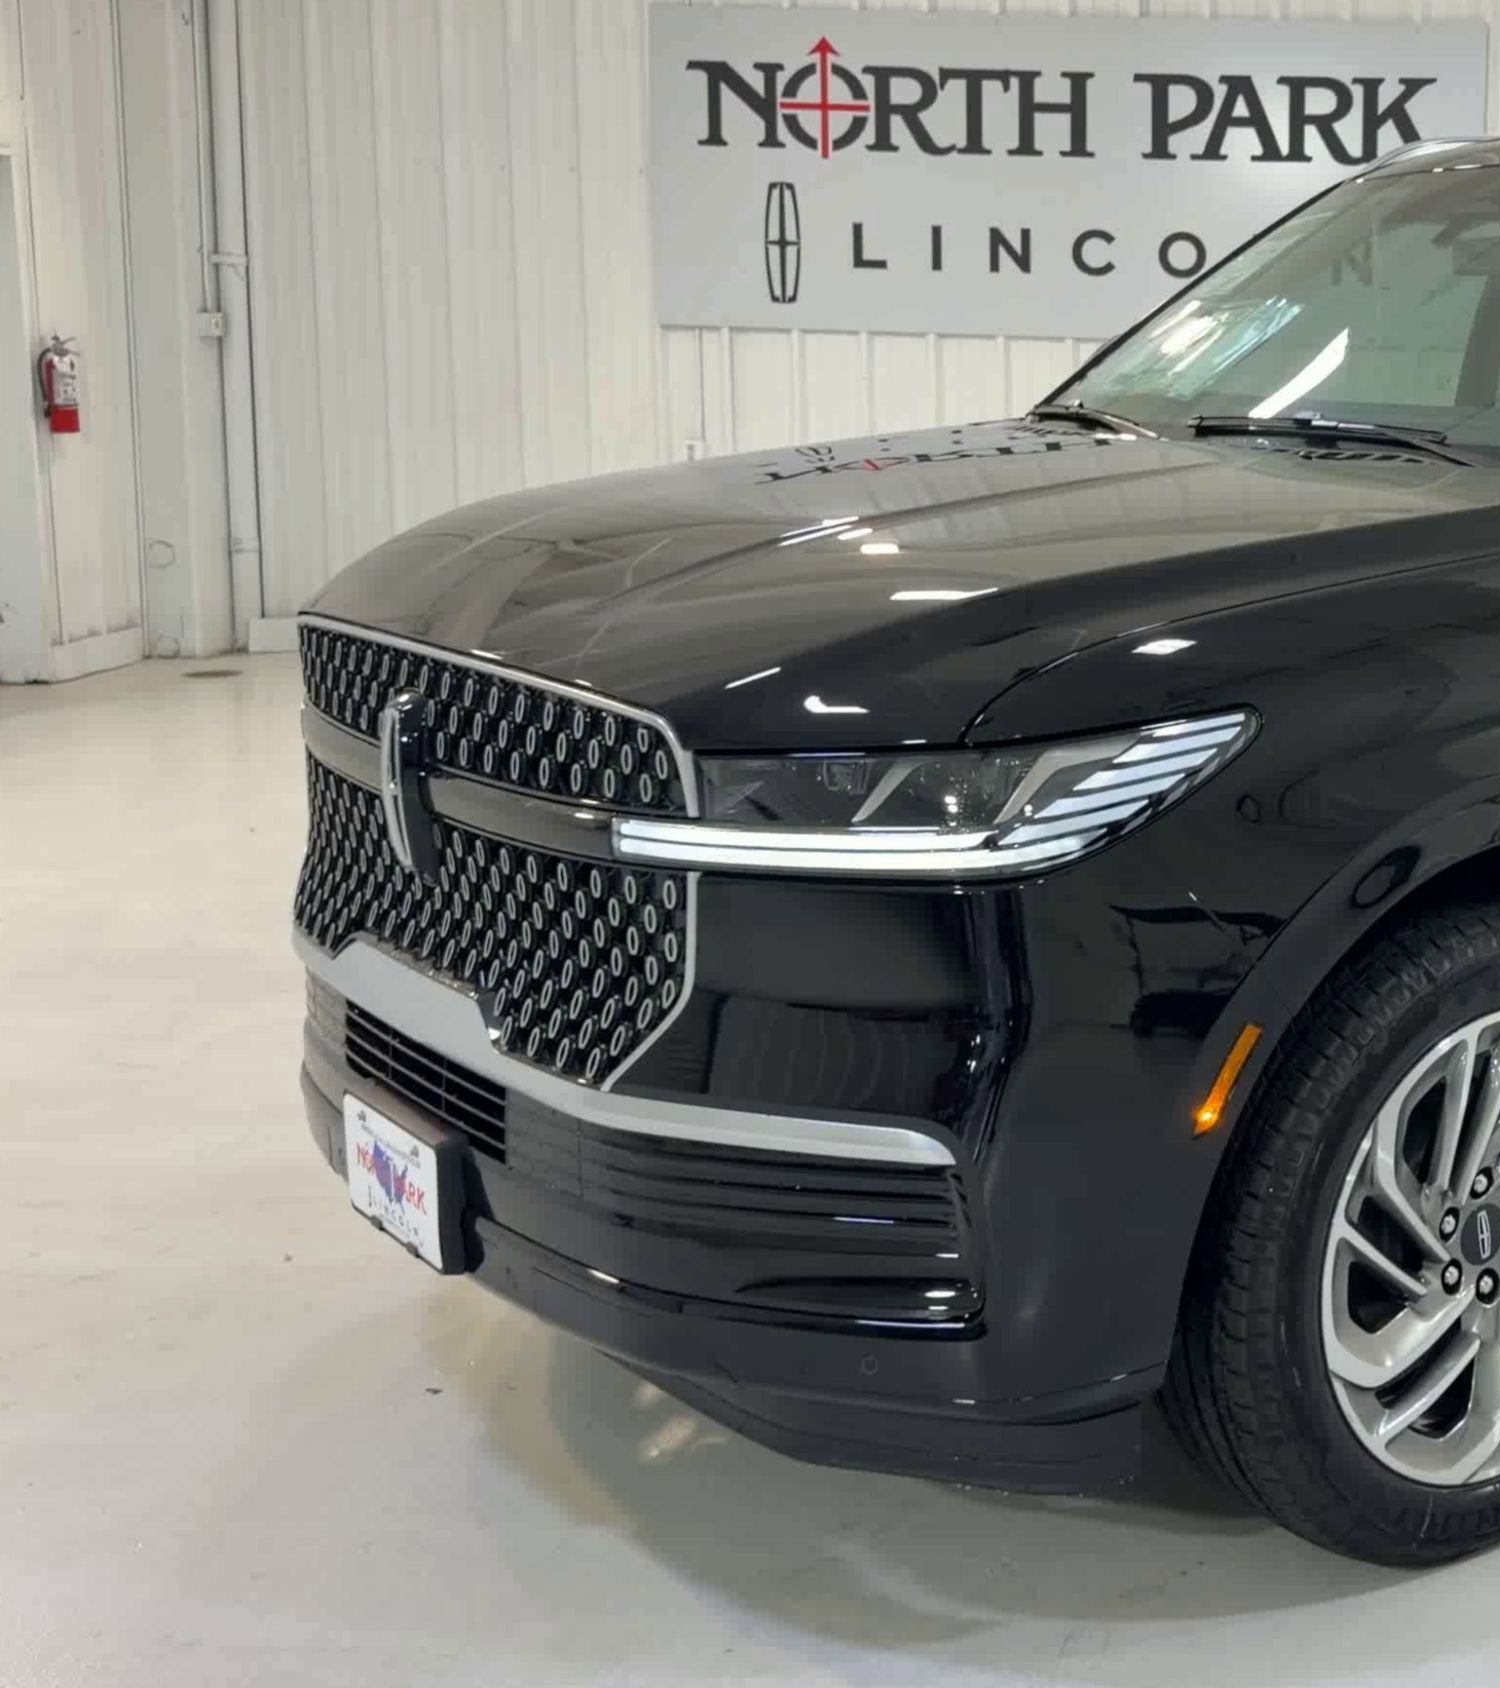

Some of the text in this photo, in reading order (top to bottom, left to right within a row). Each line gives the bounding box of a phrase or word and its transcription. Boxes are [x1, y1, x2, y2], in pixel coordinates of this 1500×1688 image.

[685, 60, 1438, 166] NORTH PARK
[851, 220, 1373, 287] LINCON
